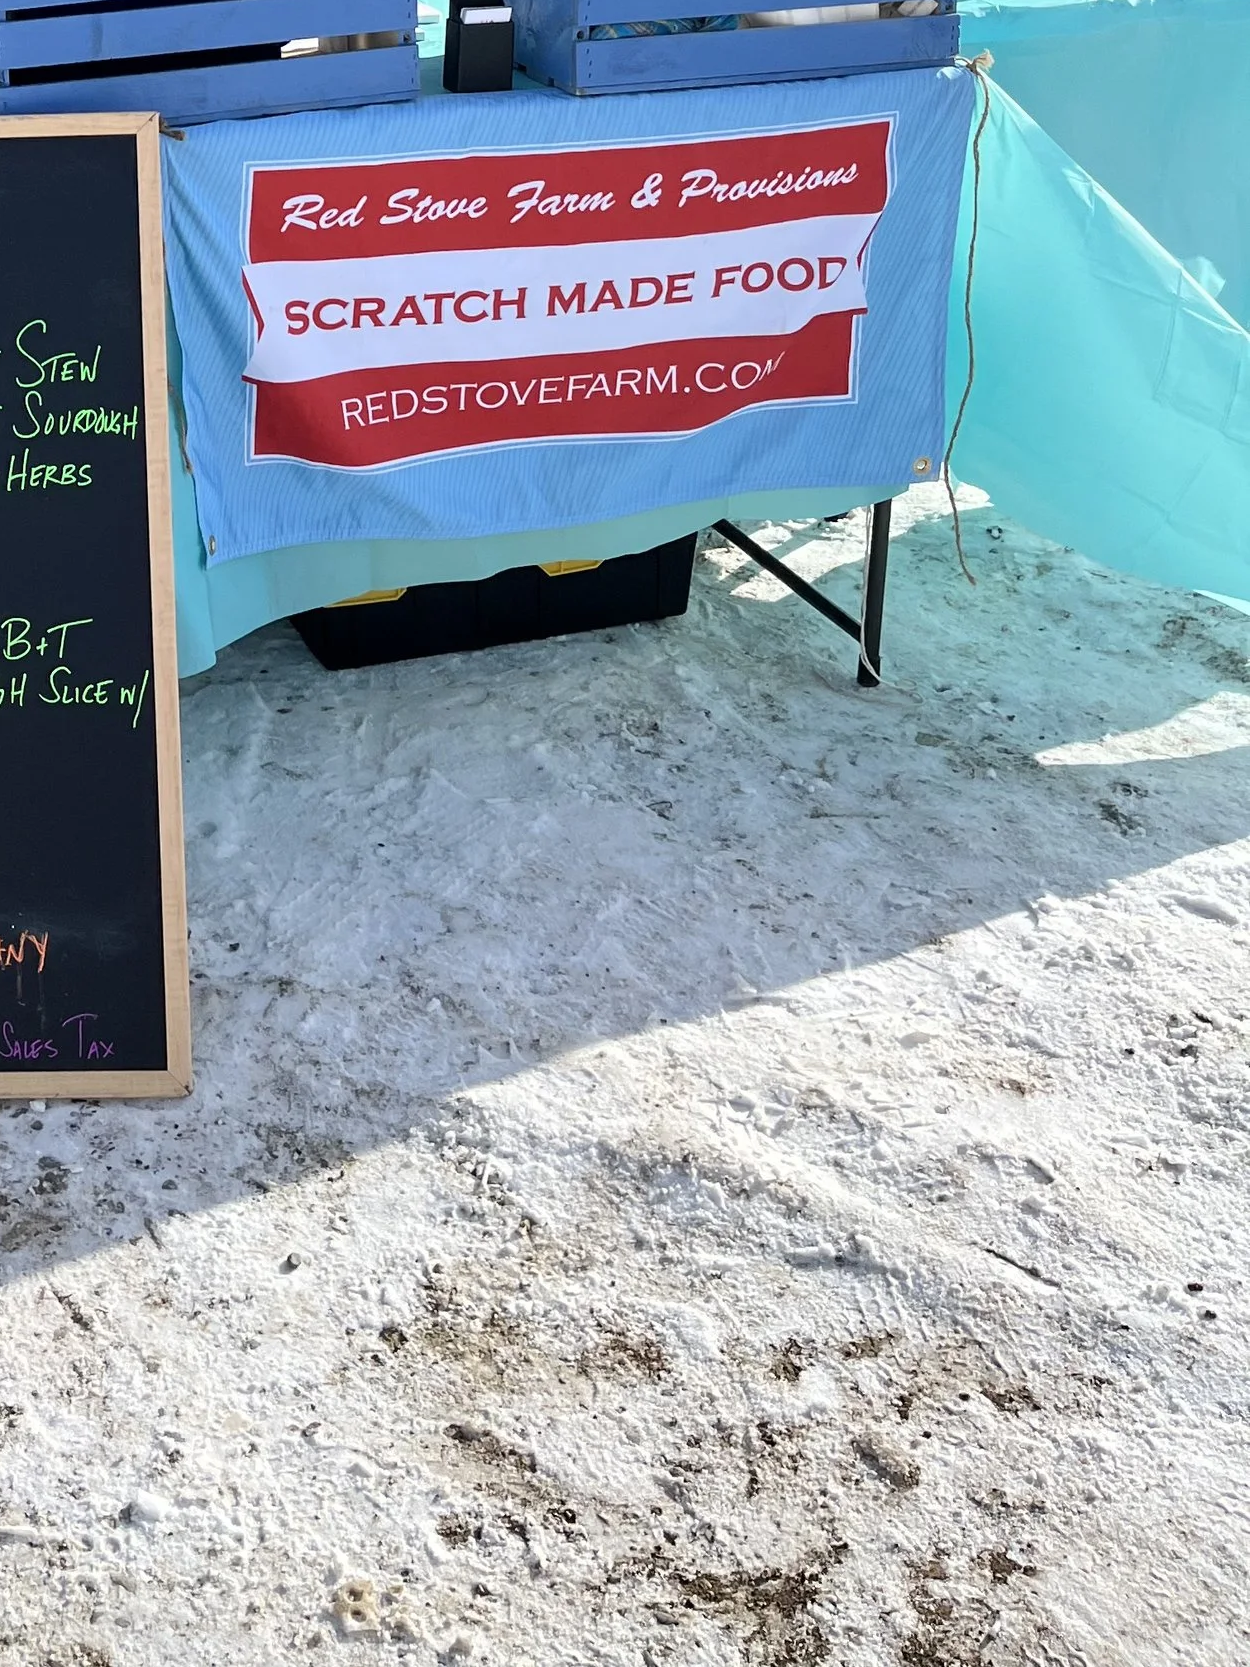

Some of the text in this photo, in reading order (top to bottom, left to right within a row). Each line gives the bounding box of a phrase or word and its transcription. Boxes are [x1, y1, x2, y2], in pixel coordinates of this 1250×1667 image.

[280, 162, 860, 233] Red Stove Farm & Provisions
[285, 256, 848, 336] SCRATCH MADE FOOD
[15, 319, 102, 388] STEW
[6, 448, 94, 493] HERBS
[38, 665, 115, 705] SLICE
[61, 1013, 116, 1061] TAX
